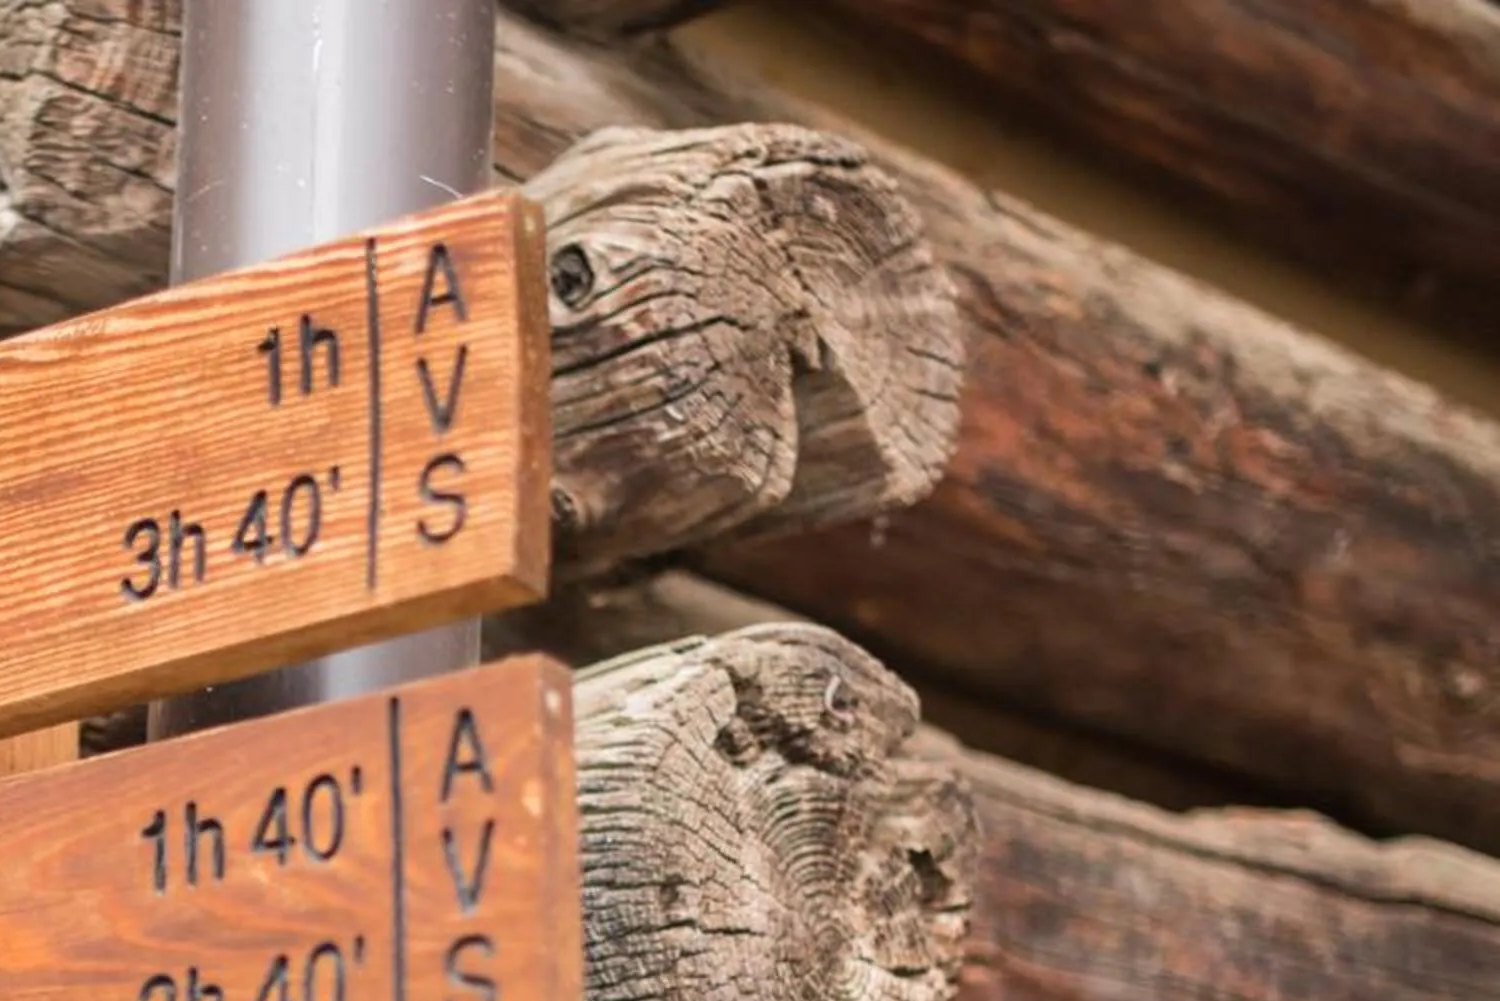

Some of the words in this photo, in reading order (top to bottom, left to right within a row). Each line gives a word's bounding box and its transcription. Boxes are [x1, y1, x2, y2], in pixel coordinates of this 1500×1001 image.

[258, 314, 339, 407] 1h
[120, 508, 206, 601] 3h
[232, 464, 341, 567] 40'
[141, 800, 226, 895] 1h
[251, 764, 362, 867] 40'
